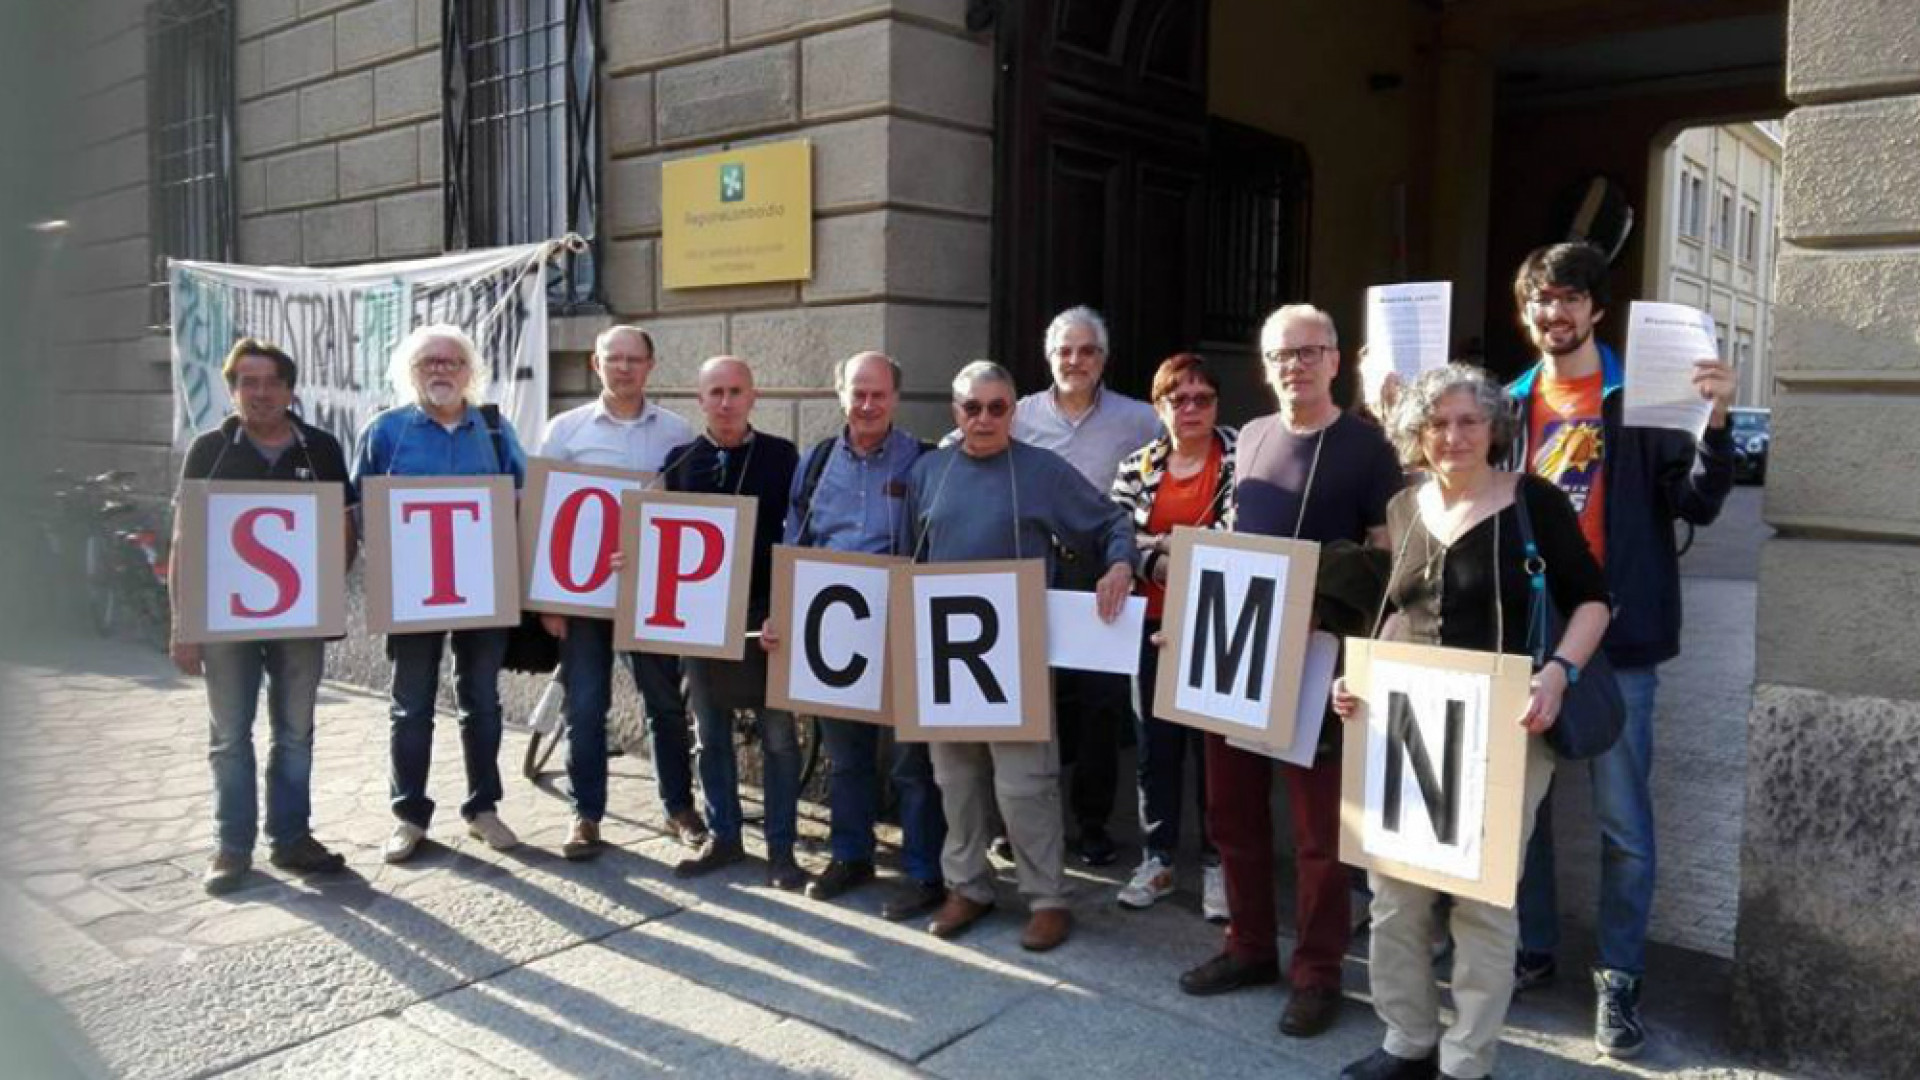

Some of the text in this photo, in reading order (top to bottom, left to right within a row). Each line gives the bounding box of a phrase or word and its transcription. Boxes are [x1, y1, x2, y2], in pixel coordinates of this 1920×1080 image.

[230, 507, 301, 617] S
[402, 501, 480, 606] T
[549, 486, 622, 593] O
[644, 516, 725, 628] P
[803, 584, 872, 688] C
[930, 596, 1008, 705] R
[1189, 568, 1277, 702] M
[1382, 692, 1466, 846] N
